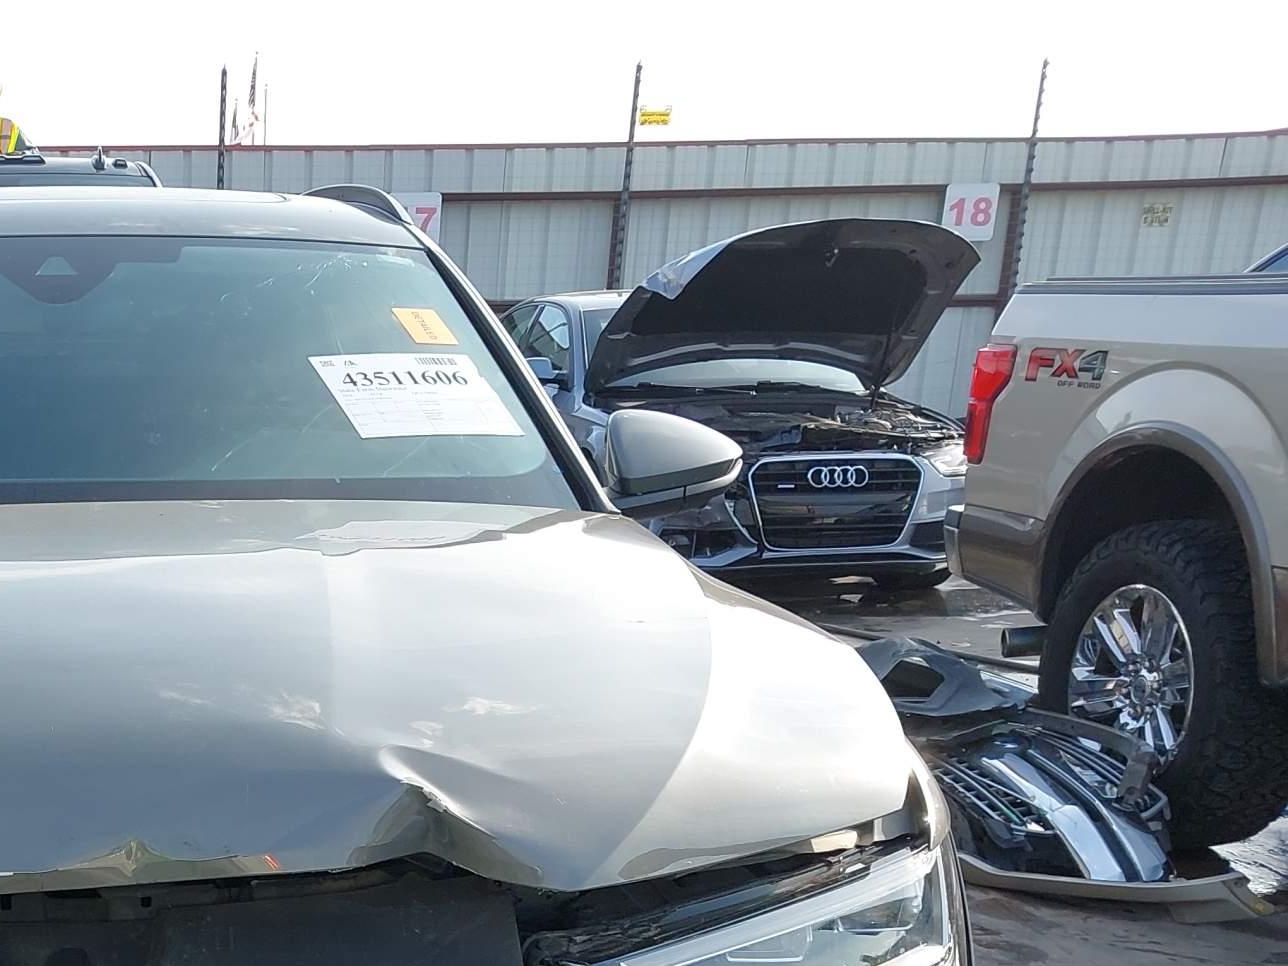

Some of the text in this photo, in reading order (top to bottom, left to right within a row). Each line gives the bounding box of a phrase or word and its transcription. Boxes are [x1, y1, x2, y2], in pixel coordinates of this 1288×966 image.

[949, 197, 993, 227] 18
[342, 370, 468, 387] 43511606
[1024, 346, 1109, 382] FX4
